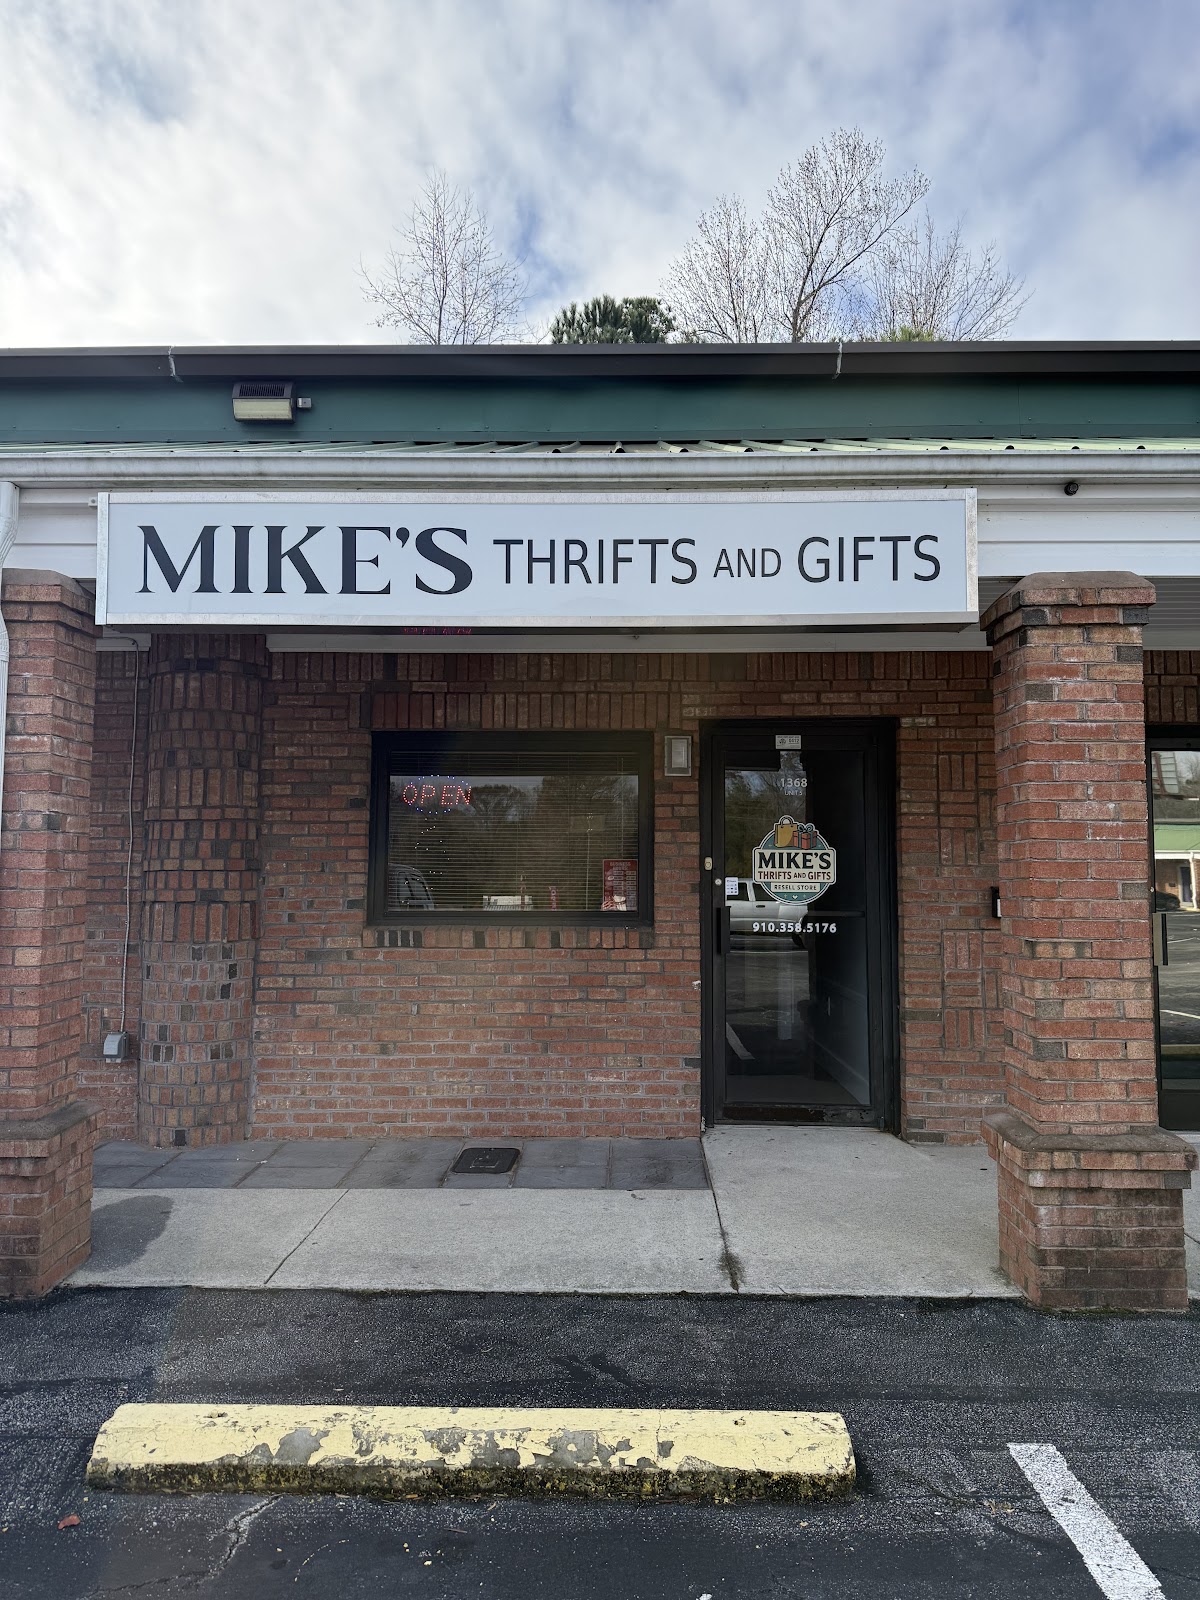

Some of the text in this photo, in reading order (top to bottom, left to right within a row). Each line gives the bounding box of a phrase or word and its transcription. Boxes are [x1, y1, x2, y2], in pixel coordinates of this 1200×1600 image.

[135, 525, 941, 596] MIKE'S THRIFTS AND GIFTS
[780, 777, 808, 788] 1368
[402, 784, 472, 805] OPEN
[757, 851, 832, 870] MIKE'S
[757, 871, 792, 880] THRIFTS
[807, 871, 831, 881] GIFTS
[752, 921, 837, 933] 910.358.5176
